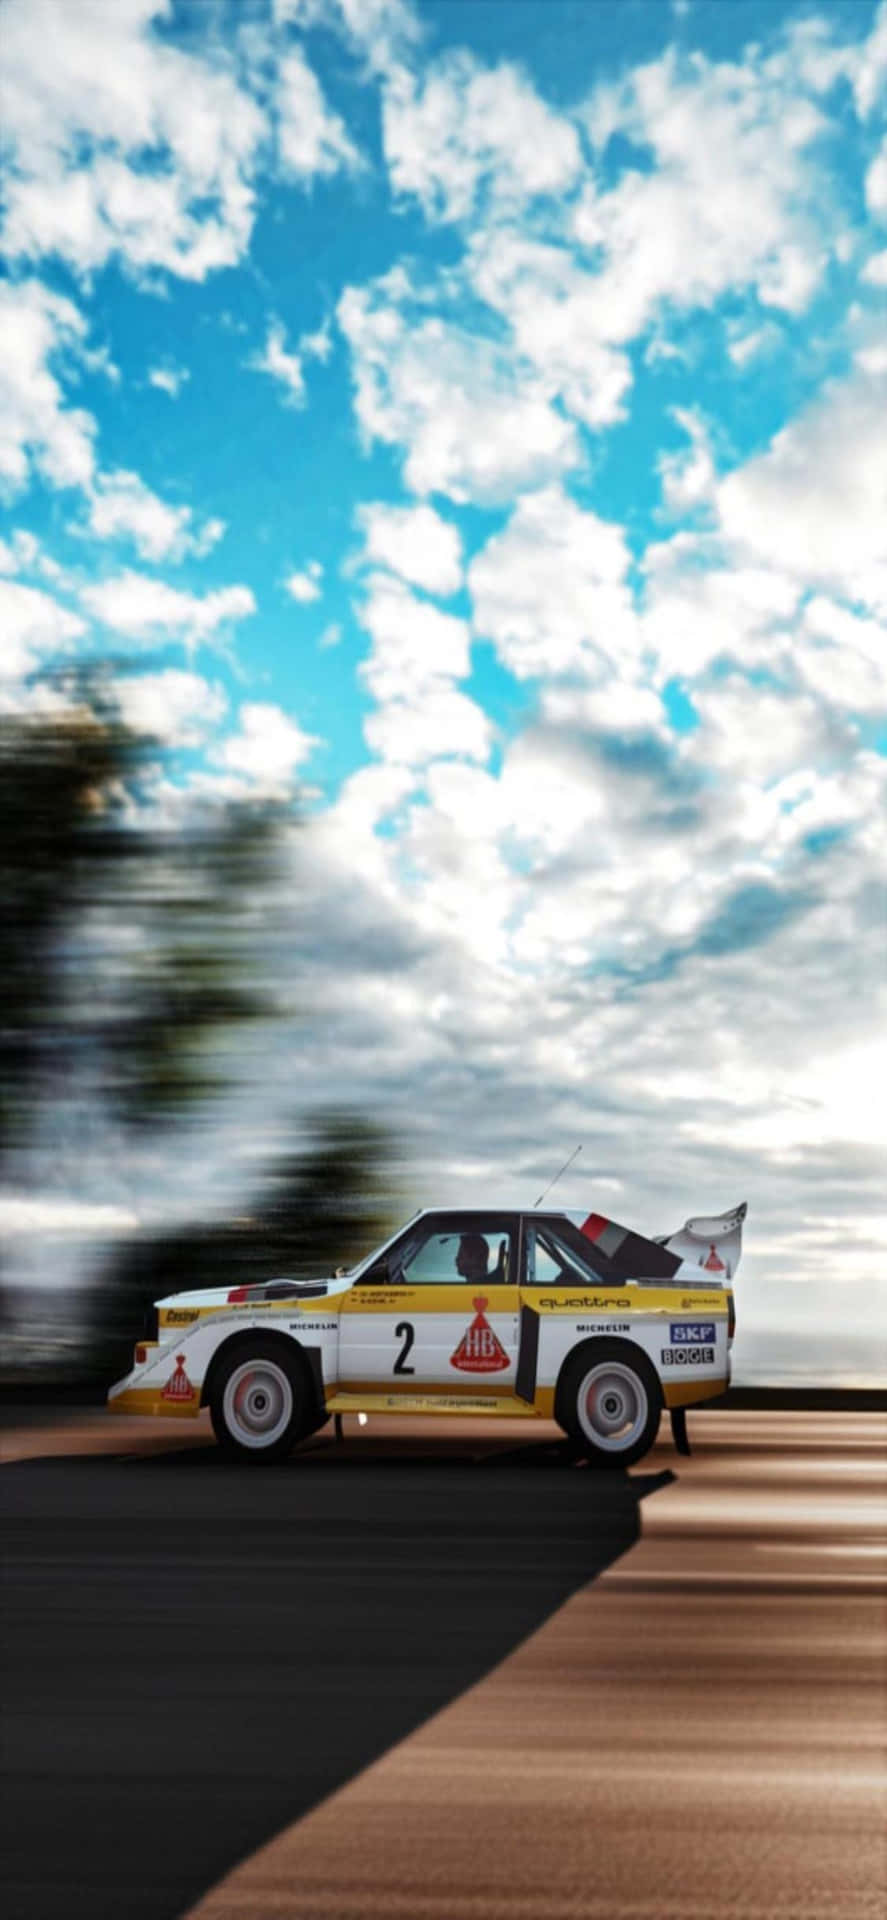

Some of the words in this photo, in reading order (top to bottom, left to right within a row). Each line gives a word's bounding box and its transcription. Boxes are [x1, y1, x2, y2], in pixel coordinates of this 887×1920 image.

[540, 1297, 632, 1310] quattro
[166, 1309, 200, 1323] Castrol
[576, 1324, 631, 1333] MICHELIN
[673, 1326, 713, 1341] SKF
[393, 1320, 415, 1376] 2
[465, 1328, 496, 1358] HB
[662, 1349, 713, 1364] BOGE
